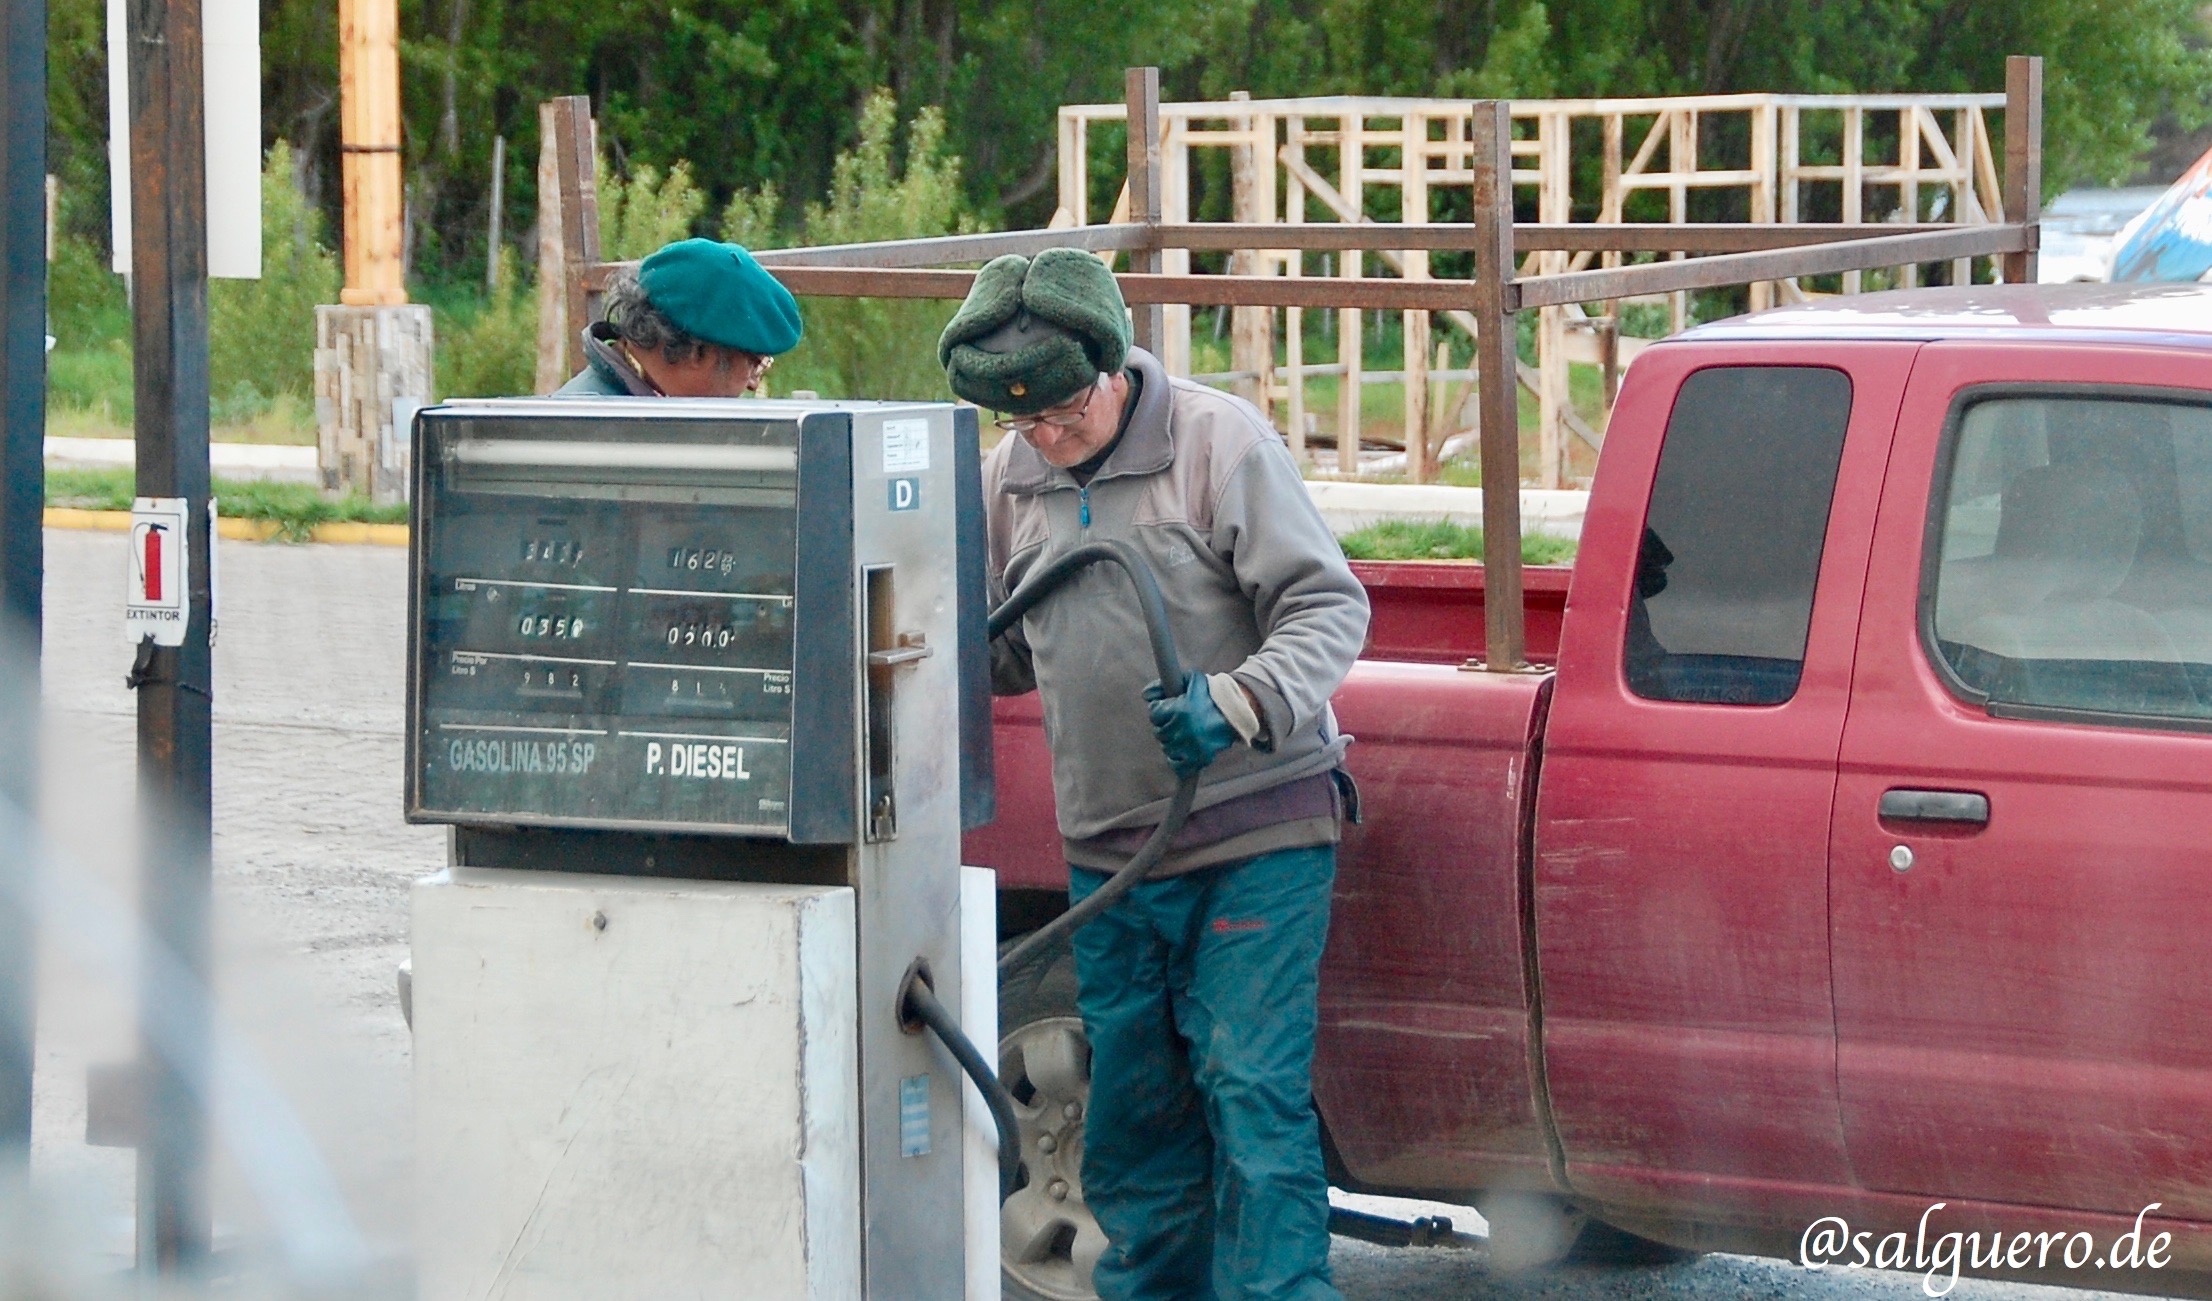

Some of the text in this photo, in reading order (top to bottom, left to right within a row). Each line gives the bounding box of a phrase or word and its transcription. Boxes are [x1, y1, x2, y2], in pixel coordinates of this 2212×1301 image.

[896, 480, 912, 508] D
[126, 609, 180, 621] EXTINTOR
[764, 672, 790, 682] Precio
[450, 739, 595, 774] GASOLINA 95 SP
[646, 742, 750, 779] P. DIESEL
